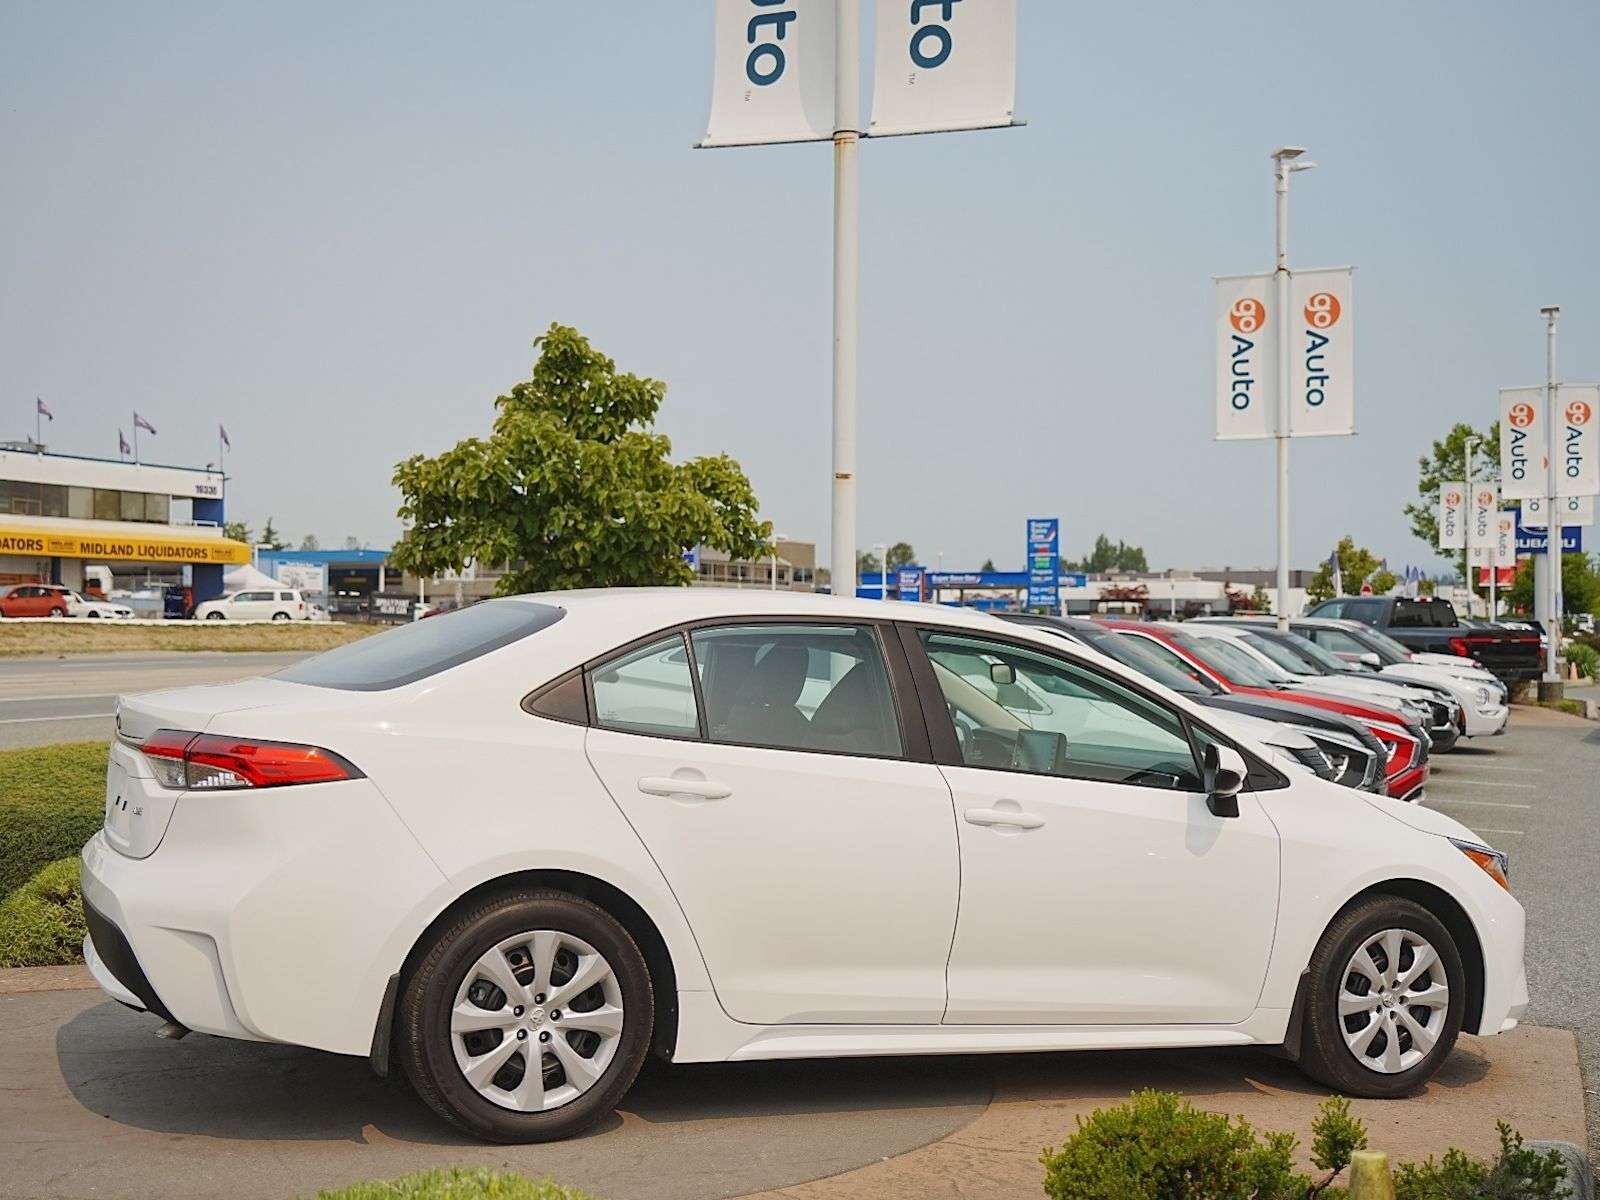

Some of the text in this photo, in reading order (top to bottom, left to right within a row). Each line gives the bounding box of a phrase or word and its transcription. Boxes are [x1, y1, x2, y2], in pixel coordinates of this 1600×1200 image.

[746, 0, 797, 86] to
[1231, 299, 1258, 410] go Auto
[1303, 294, 1332, 406] go Auto
[1510, 428, 1528, 480] Auto
[1566, 426, 1583, 477] Auto
[0, 538, 44, 551] ATORS
[80, 542, 208, 559] MIDLAND LIQUIDATORS
